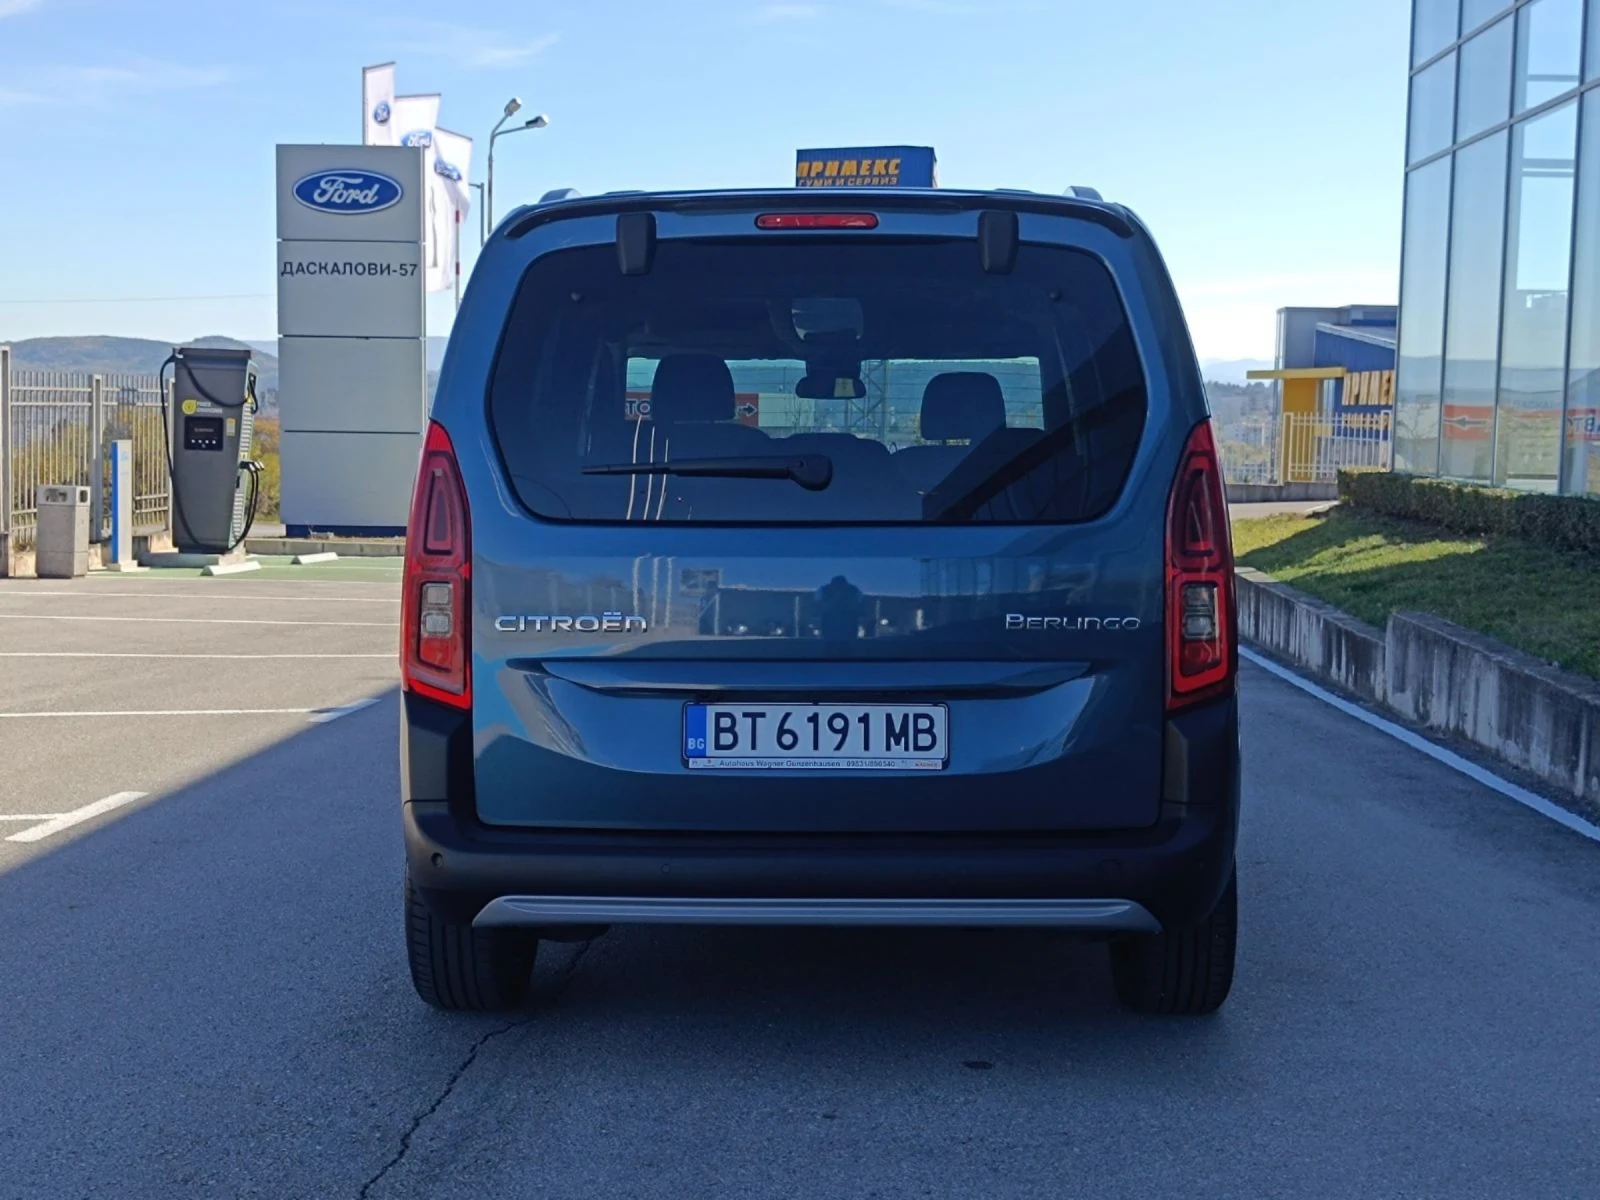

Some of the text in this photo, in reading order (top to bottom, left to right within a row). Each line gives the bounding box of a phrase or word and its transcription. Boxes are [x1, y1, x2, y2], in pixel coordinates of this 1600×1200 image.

[797, 159, 901, 177] ПРИМЕКС
[798, 177, 898, 187] ГУМИ И СЕРВИЗ
[313, 175, 379, 205] Ford
[281, 261, 418, 278] ДАСКАЛОВИ-57
[687, 738, 705, 750] BG
[719, 759, 754, 767] Autohaus
[756, 760, 784, 769] Wagner
